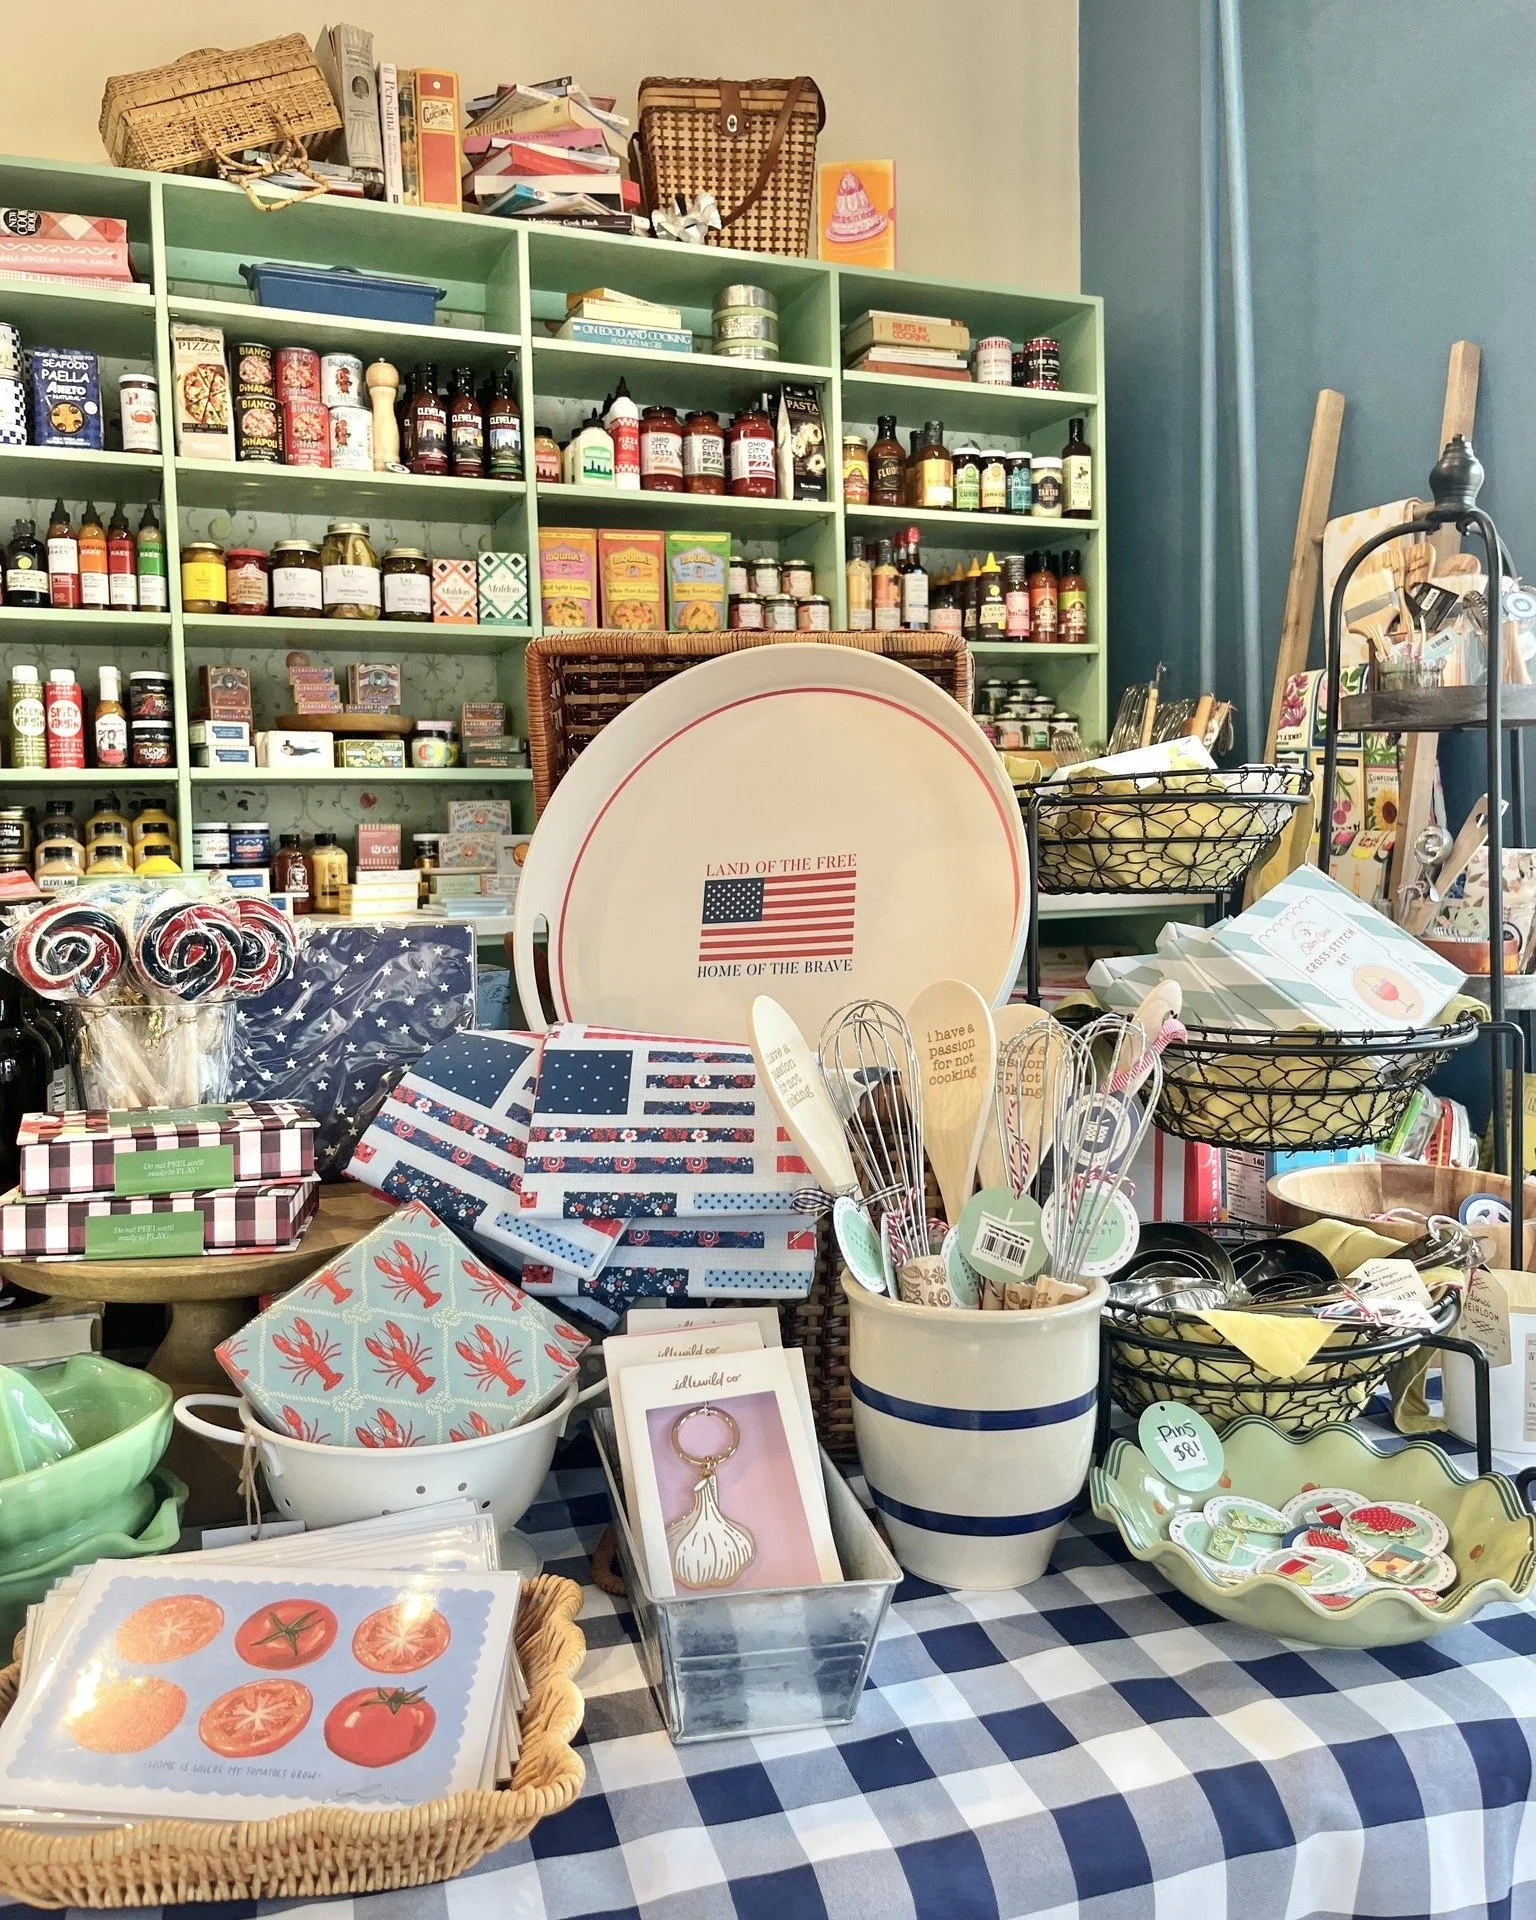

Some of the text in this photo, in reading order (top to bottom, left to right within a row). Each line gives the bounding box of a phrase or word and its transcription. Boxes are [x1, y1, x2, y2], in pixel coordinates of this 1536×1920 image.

[384, 79, 396, 135] Persiana
[892, 321, 917, 332] FRUITS
[583, 325, 691, 344] ON FOOD AND COOKING
[892, 330, 931, 343] COOKING
[178, 342, 220, 353] PIZZA
[239, 347, 271, 359] BIANCO
[41, 358, 89, 370] SEAFOOD
[281, 352, 314, 363] BIANCO
[41, 369, 90, 384] PAELLA
[241, 400, 276, 411] BIANCO
[291, 404, 324, 416] BIANCO
[786, 400, 819, 412] PASTA
[621, 443, 635, 451] OIL
[702, 444, 718, 452] CITY
[702, 451, 723, 459] PASTA
[441, 587, 470, 596] Maldon
[487, 584, 520, 594] Maldon
[705, 853, 857, 877] LAND OF THE FREE
[1335, 952, 1350, 967] KIT
[697, 958, 853, 978] HOME OF THE BRAVE
[934, 1026, 966, 1042] have
[967, 1023, 975, 1034] a
[929, 1038, 976, 1060] passion
[932, 1052, 974, 1071] for not
[929, 1065, 978, 1086] cooking
[657, 1343, 720, 1359] idlewild co
[672, 1372, 742, 1391] idlewild co
[146, 1760, 175, 1772] HOME
[179, 1761, 189, 1772] IS
[192, 1763, 223, 1774] WHERE
[227, 1766, 242, 1776] MY
[291, 1768, 317, 1780] GROW
